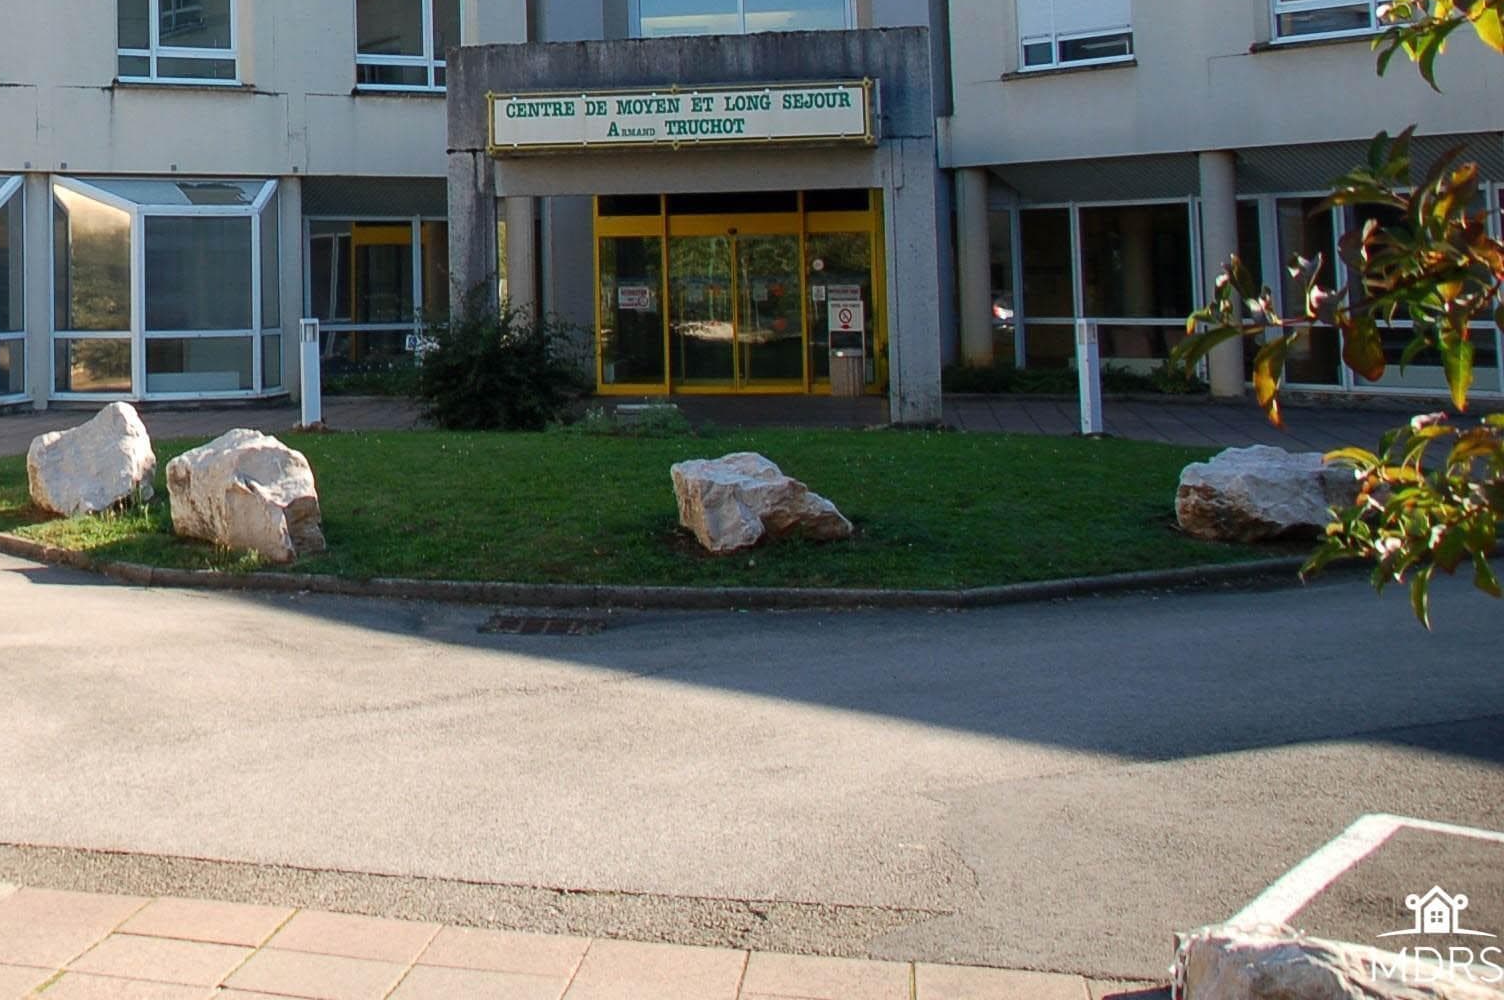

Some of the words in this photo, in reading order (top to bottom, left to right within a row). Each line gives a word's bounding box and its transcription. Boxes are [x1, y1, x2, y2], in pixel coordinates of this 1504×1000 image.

[506, 101, 575, 118] CENTRE
[585, 100, 607, 116] DE
[616, 97, 680, 115] MOYEN
[691, 95, 713, 112] ET
[724, 94, 771, 111] LONG
[782, 92, 851, 109] SEJOUR
[665, 118, 745, 136] TRUCHOT
